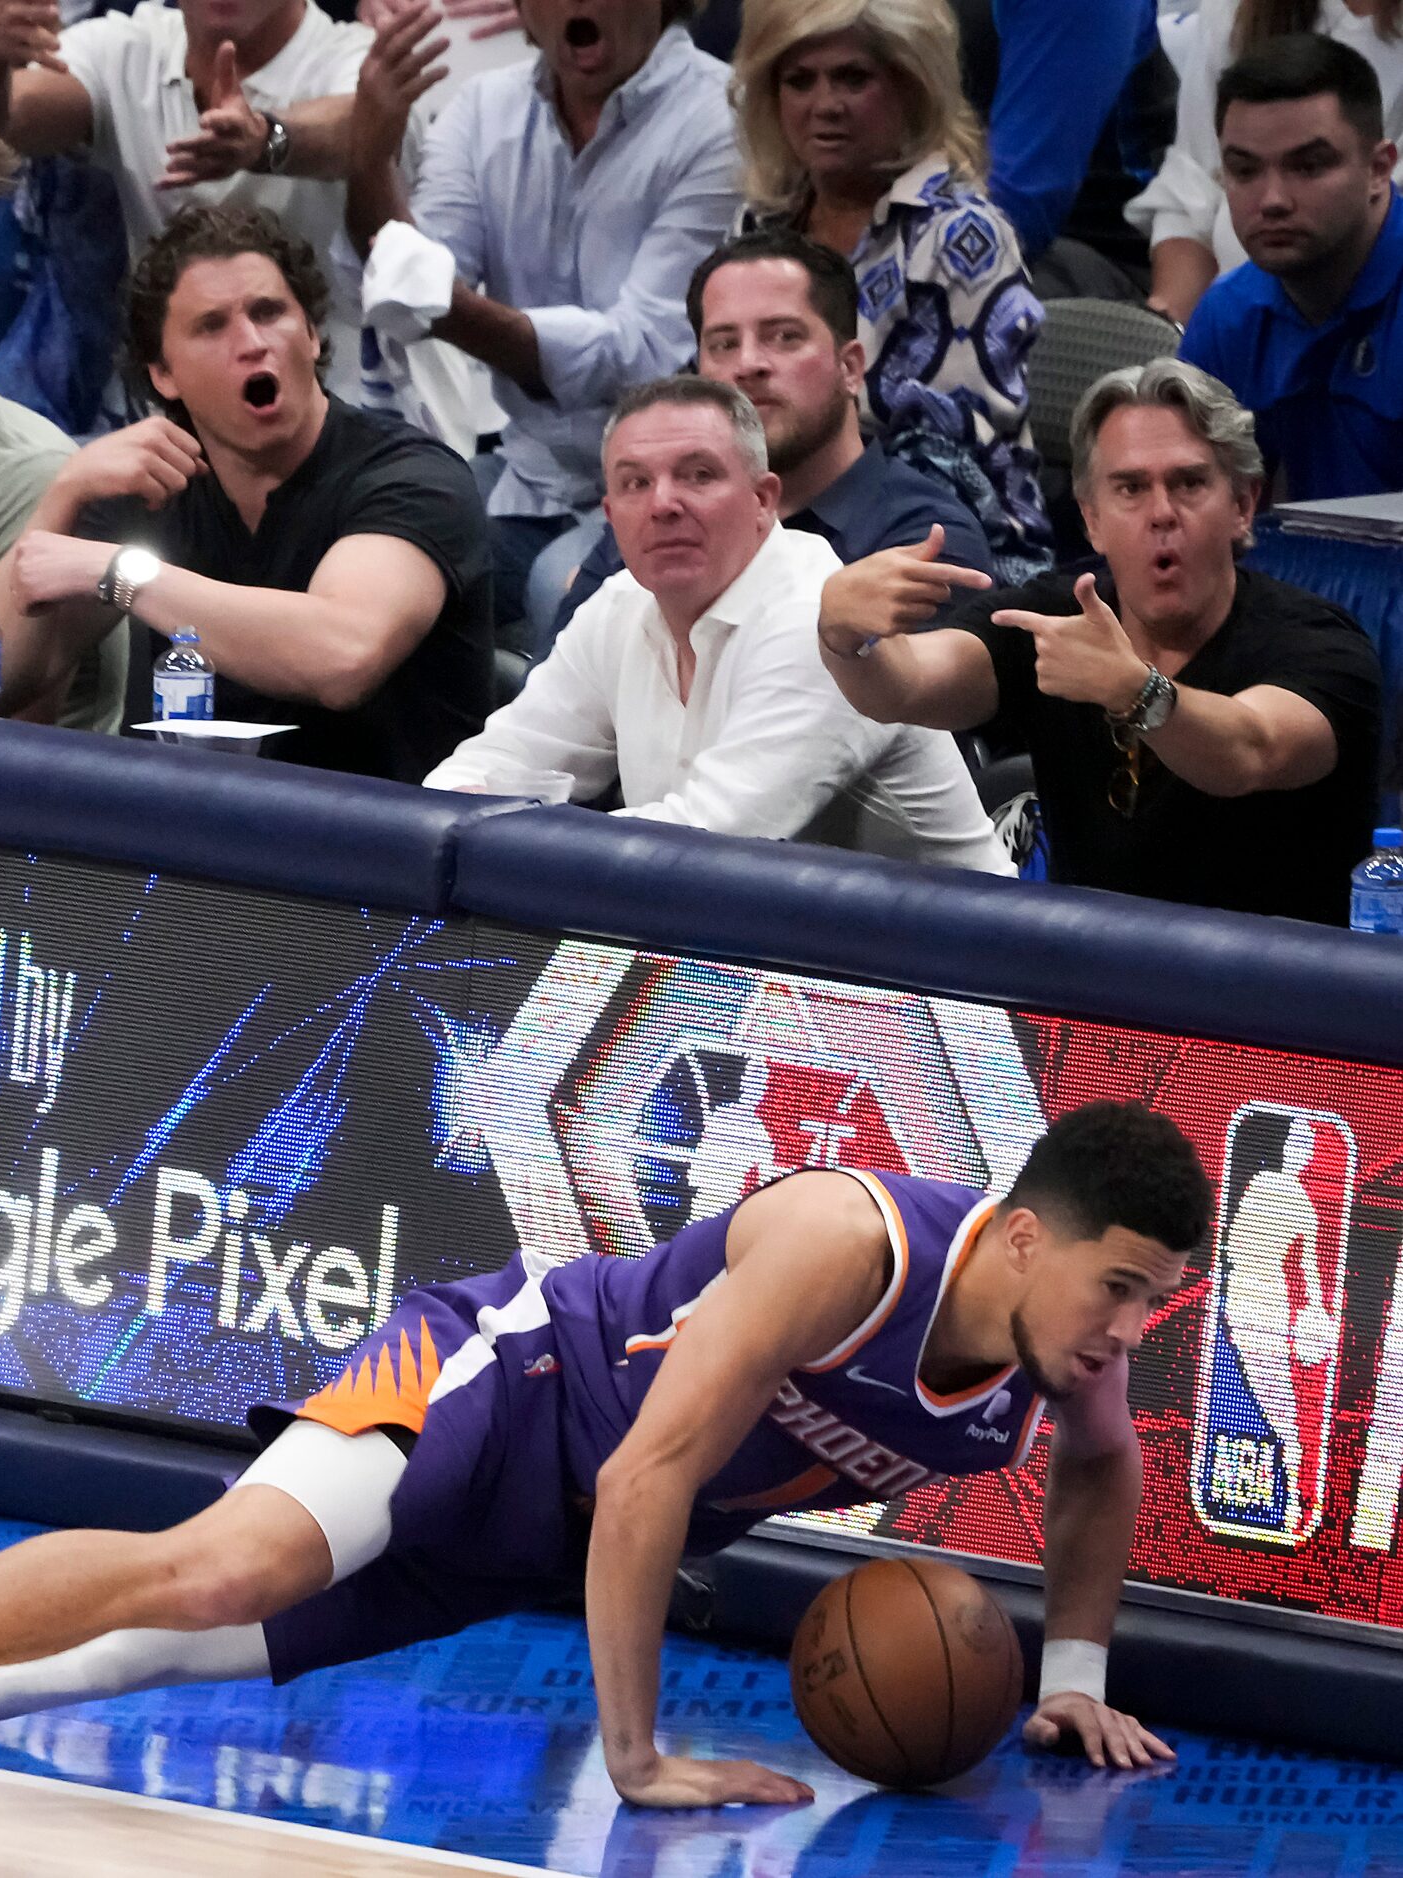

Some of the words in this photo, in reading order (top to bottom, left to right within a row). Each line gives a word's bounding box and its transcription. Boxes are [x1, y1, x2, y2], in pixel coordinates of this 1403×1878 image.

[9, 929, 77, 1115] by
[144, 1166, 400, 1350] Pixel
[964, 1422, 1011, 1445] PayPal
[1208, 1434, 1276, 1508] NBA
[417, 1694, 590, 1716] KURT
[1172, 1785, 1397, 1809] HUBER
[1238, 1810, 1403, 1826] BRENDA
